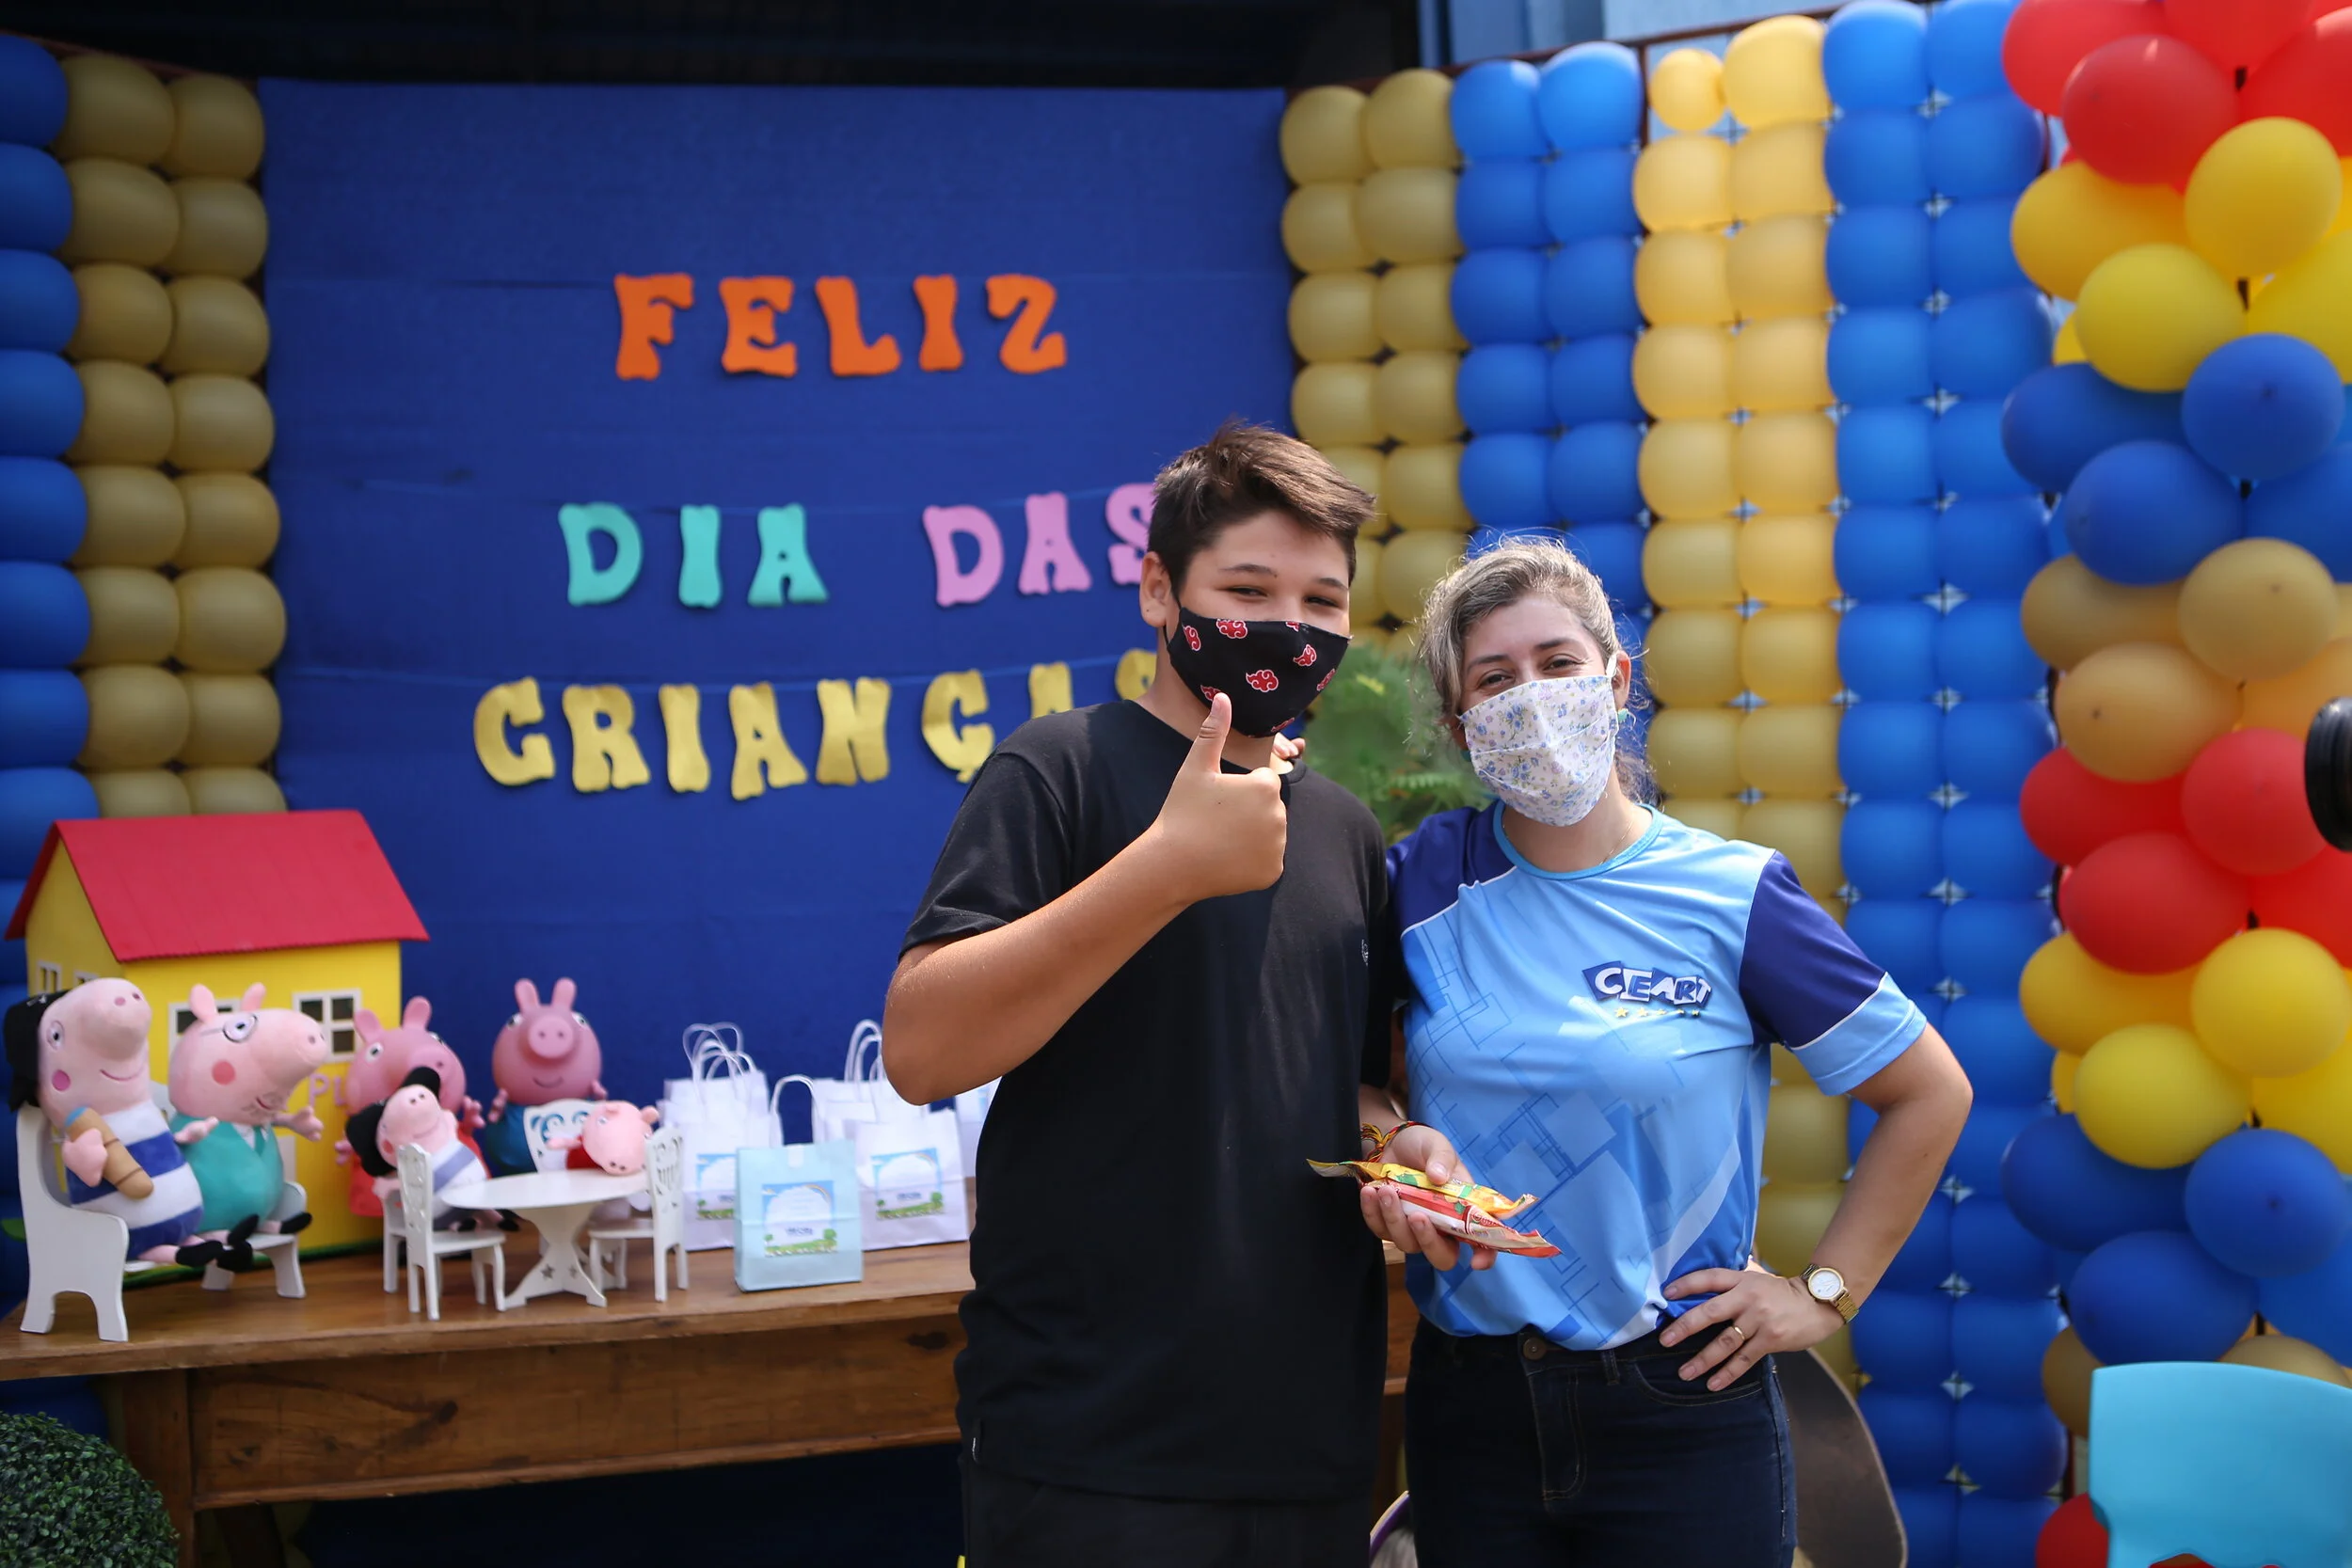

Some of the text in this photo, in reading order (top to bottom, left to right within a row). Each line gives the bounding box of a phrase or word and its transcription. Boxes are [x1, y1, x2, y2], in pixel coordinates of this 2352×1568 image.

[614, 273, 1067, 380] FELIZ
[558, 482, 1155, 608] DIA DAS
[1593, 966, 1712, 1006] CEART
